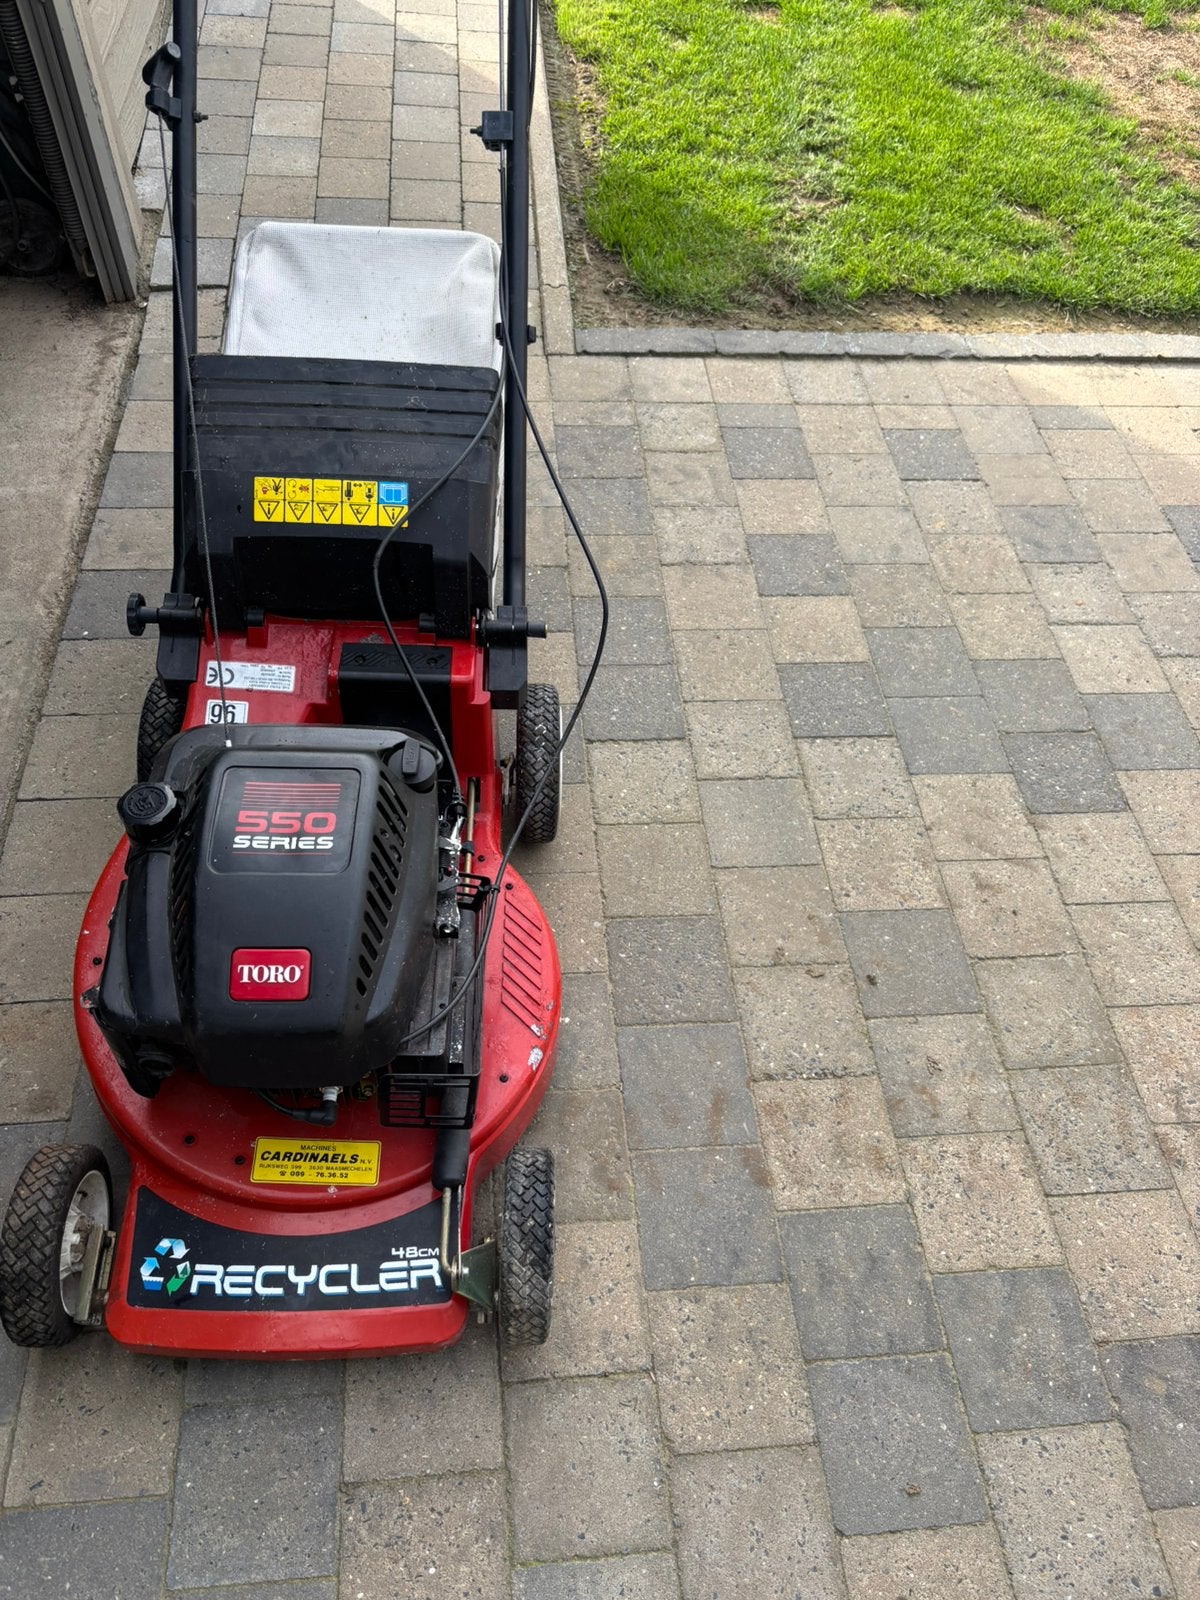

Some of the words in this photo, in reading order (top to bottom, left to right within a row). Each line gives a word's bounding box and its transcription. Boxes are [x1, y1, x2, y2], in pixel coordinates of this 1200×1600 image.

[234, 810, 337, 834] 550
[232, 835, 334, 850] SERIES
[237, 964, 302, 984] TORO
[300, 1144, 337, 1152] MACHINES
[260, 1150, 360, 1164] CARDINAELS
[190, 1258, 443, 1296] RECYCLER
